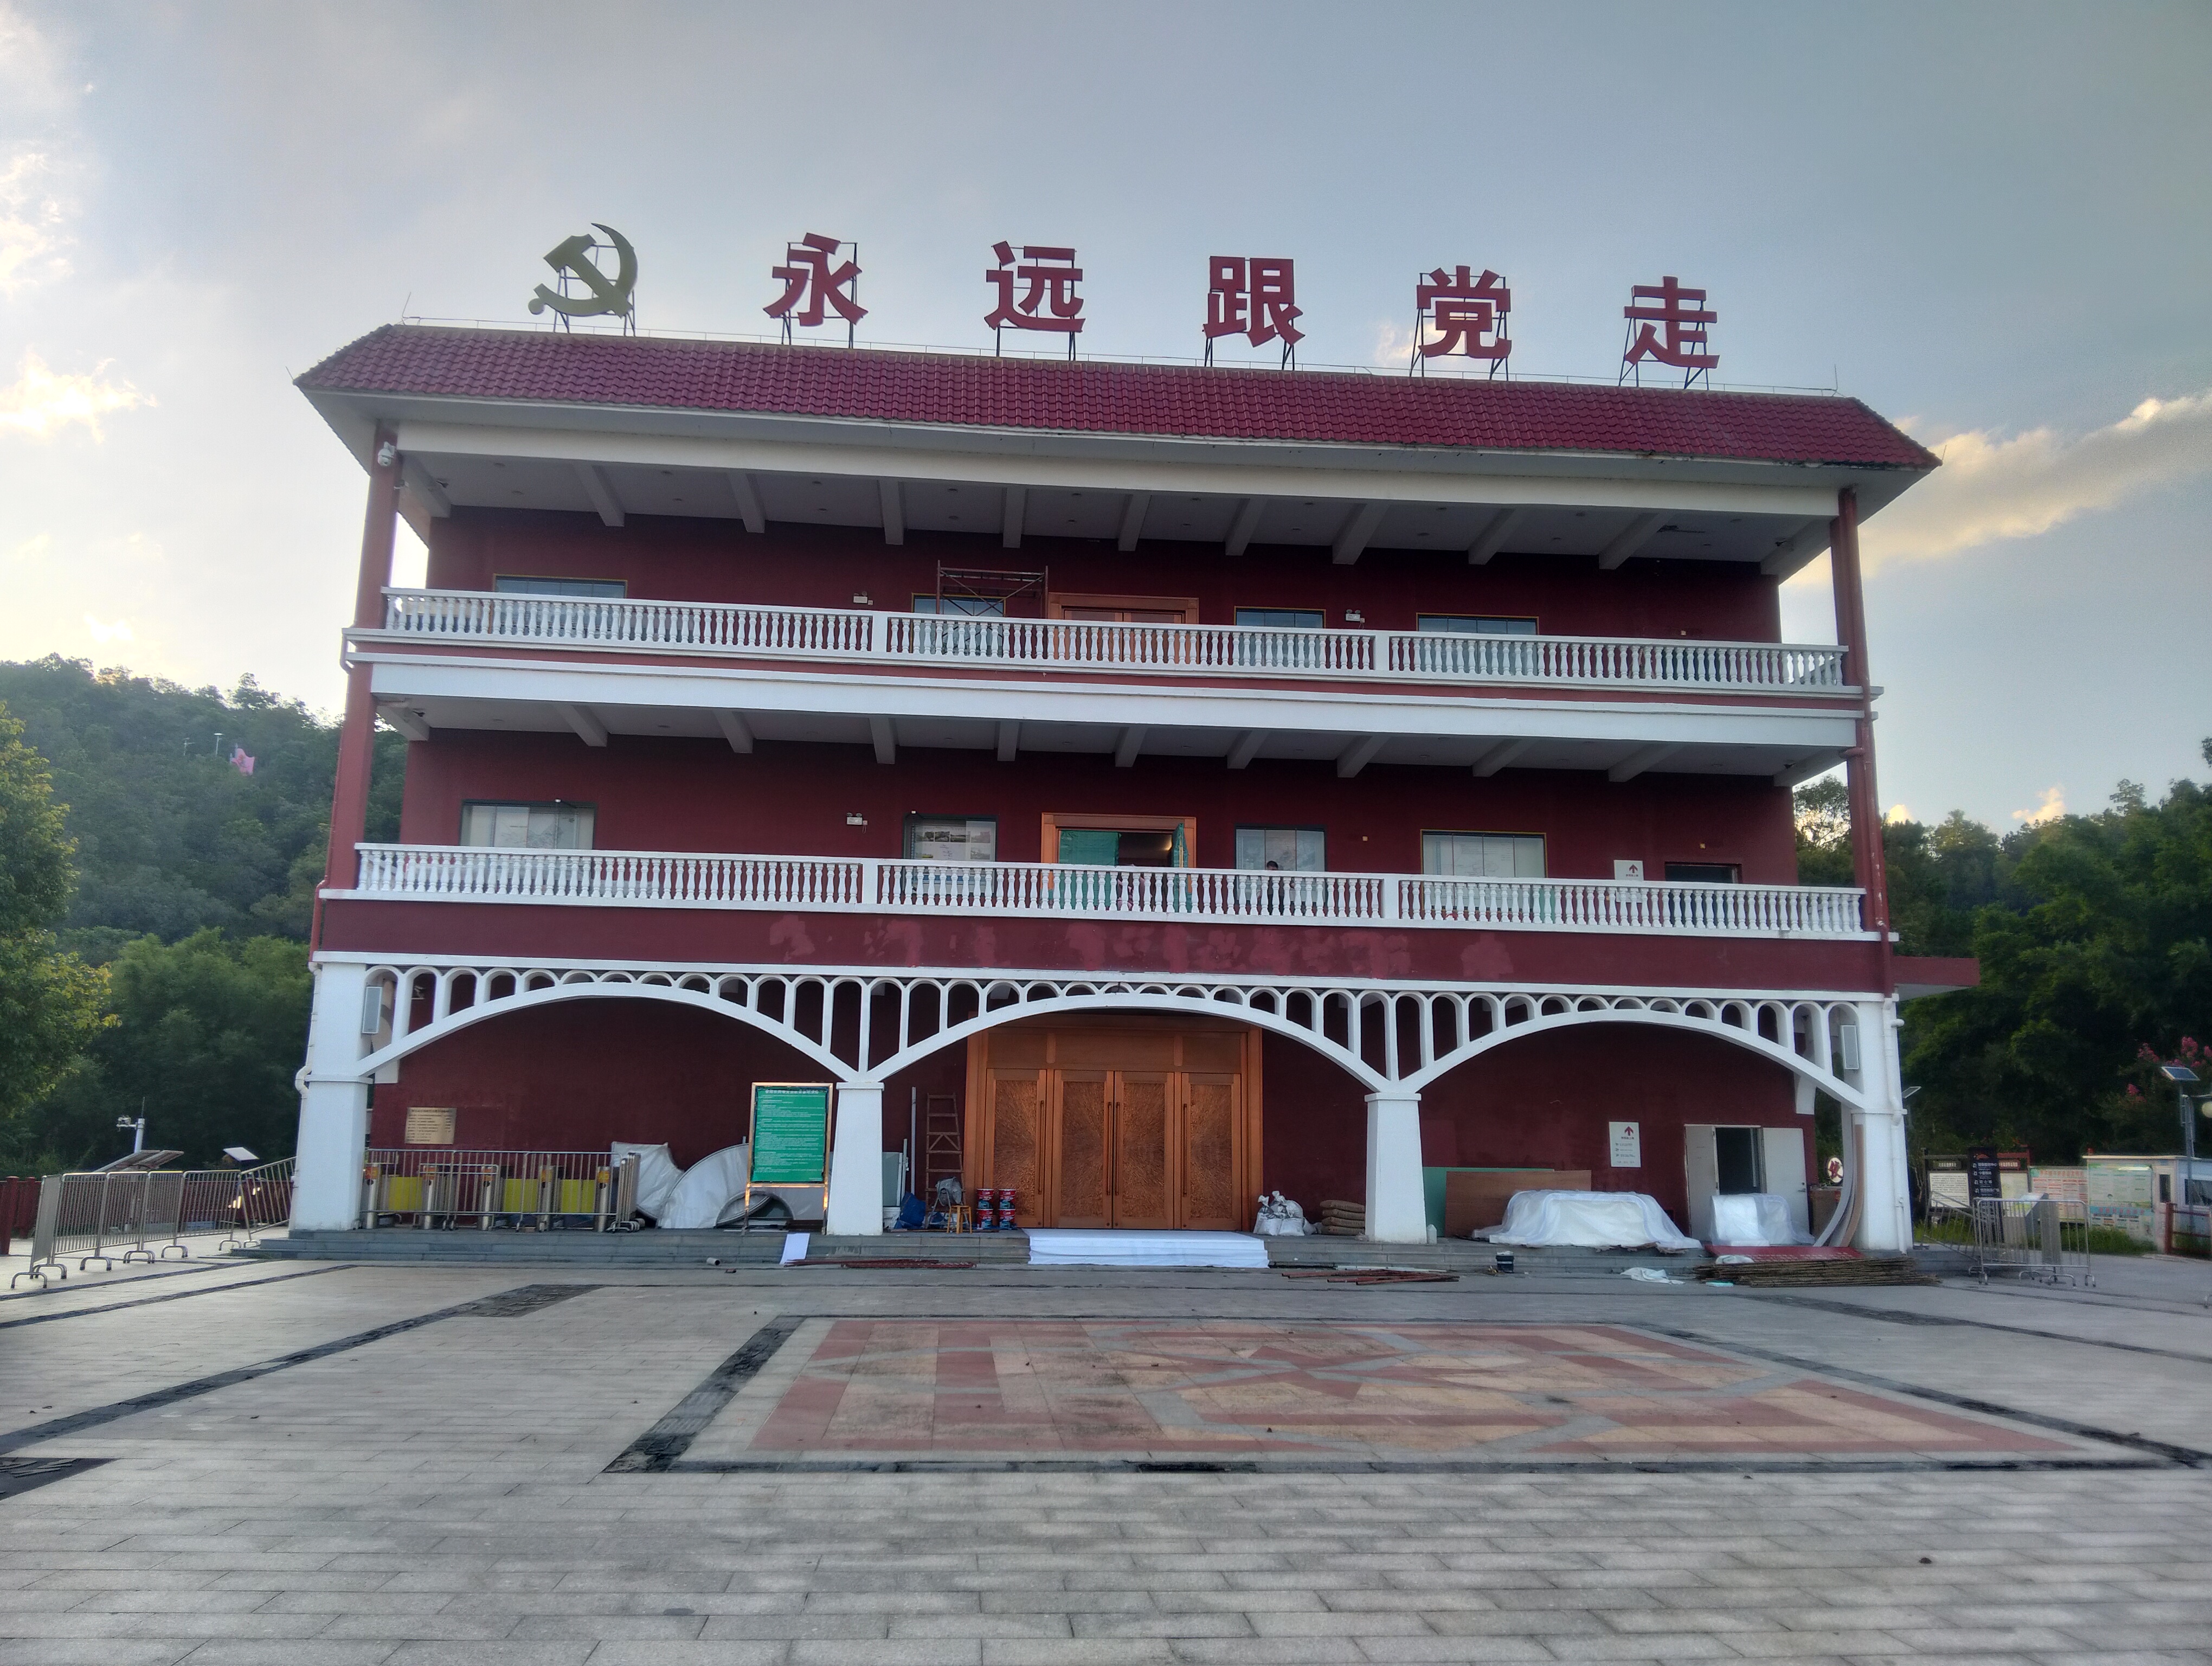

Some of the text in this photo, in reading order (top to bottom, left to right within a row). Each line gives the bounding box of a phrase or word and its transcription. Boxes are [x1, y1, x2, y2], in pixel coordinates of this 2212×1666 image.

[763, 233, 1720, 368] 永远跟党走
